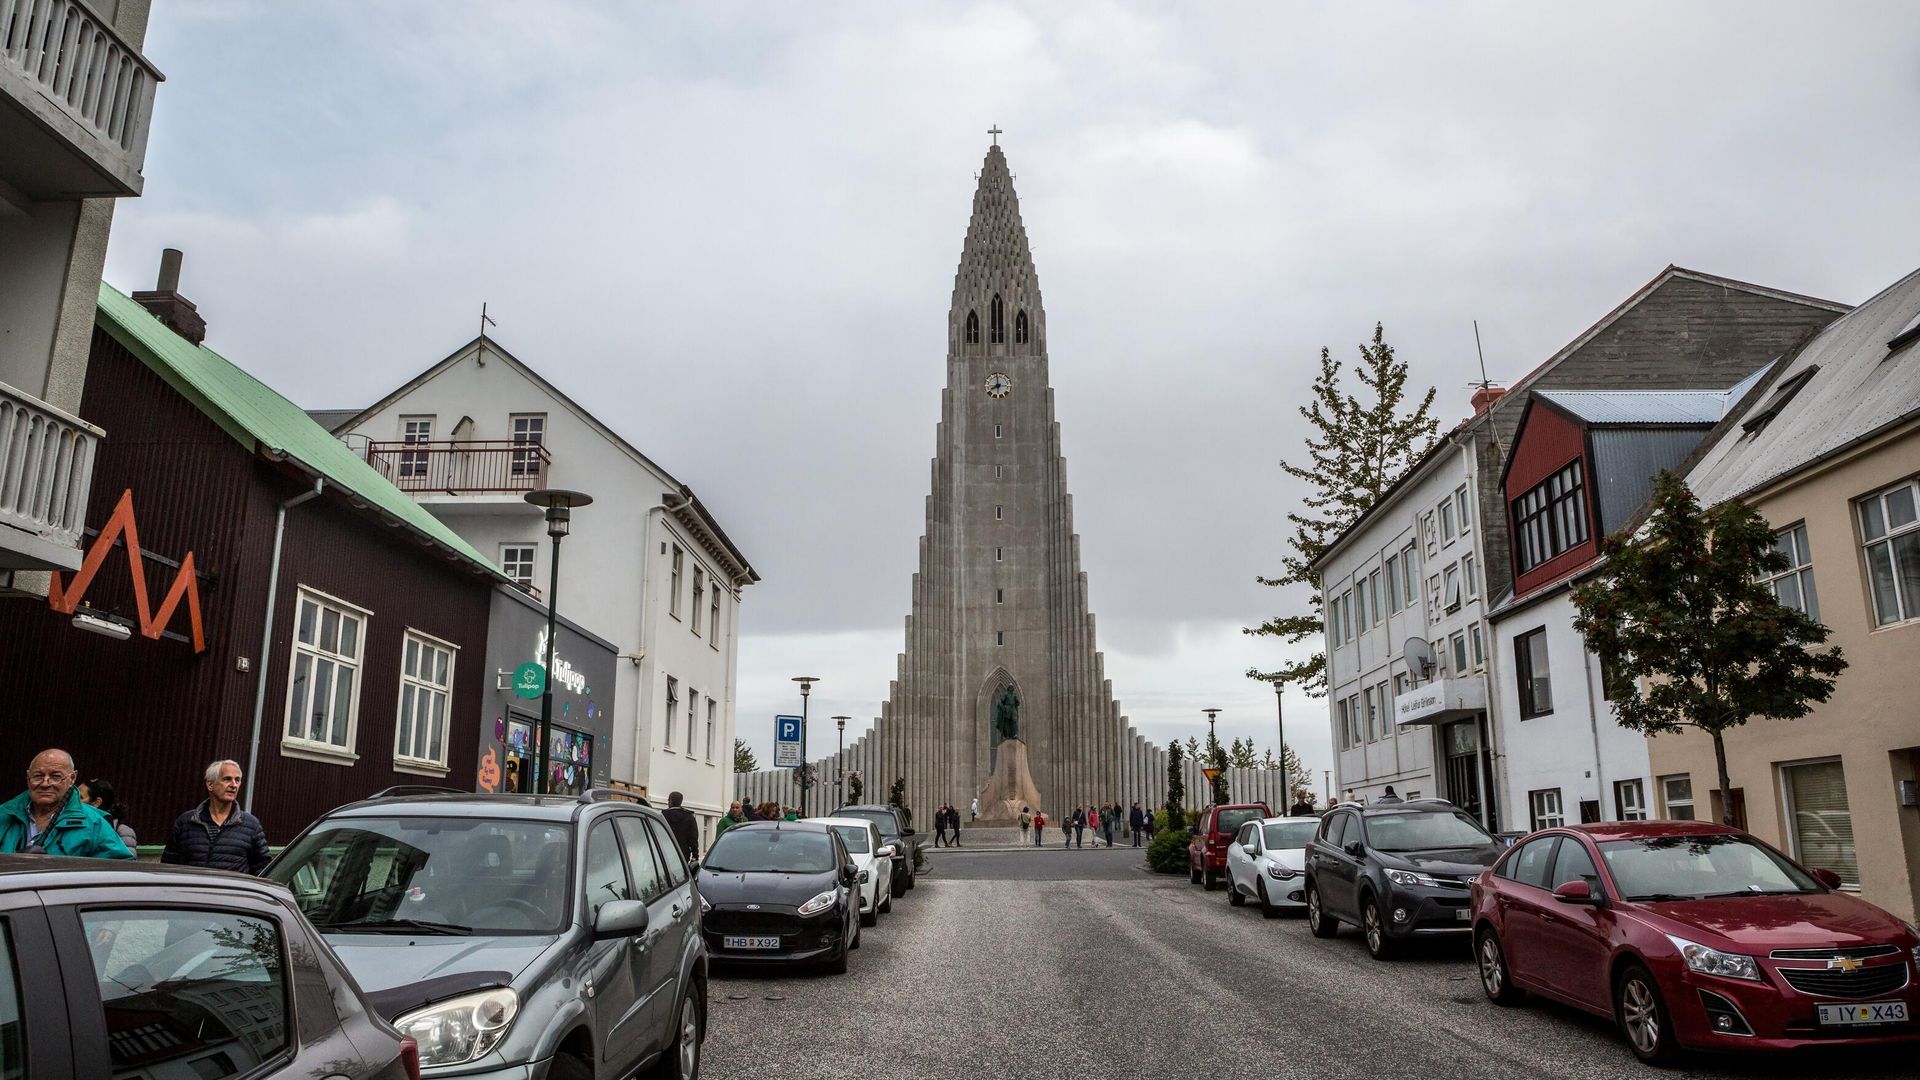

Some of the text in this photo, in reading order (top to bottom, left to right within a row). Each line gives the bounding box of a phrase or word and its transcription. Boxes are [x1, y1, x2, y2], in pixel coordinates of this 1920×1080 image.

[784, 723, 795, 738] P
[732, 938, 778, 947] HB X92
[1839, 1004, 1905, 1021] IY X43
